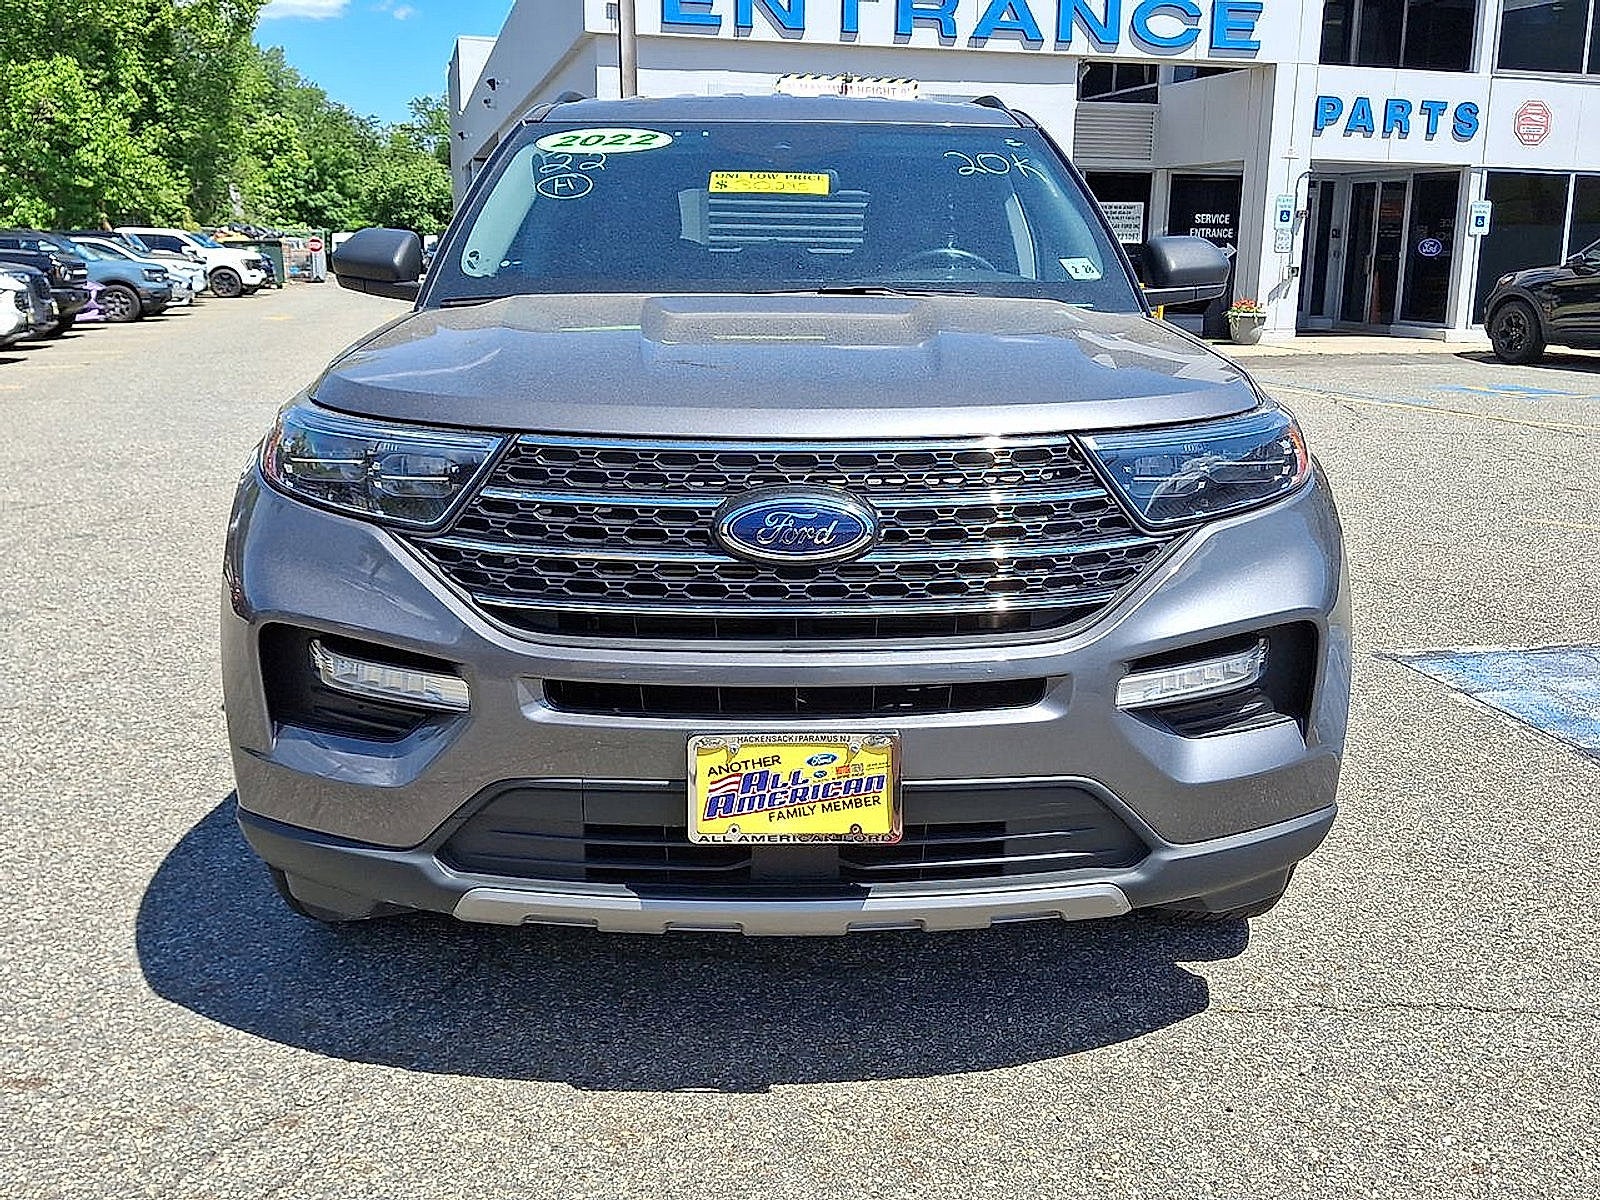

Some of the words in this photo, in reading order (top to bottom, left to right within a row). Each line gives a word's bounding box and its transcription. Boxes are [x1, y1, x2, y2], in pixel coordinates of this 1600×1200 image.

[1312, 95, 1480, 141] PARTS
[551, 133, 659, 148] 2022
[1195, 213, 1230, 224] SERVICE
[1190, 228, 1233, 238] ENTRANCE
[756, 510, 839, 545] Ford
[840, 735, 850, 743] NJ
[707, 754, 782, 778] ANOTHER
[739, 769, 810, 795] ALL
[705, 774, 885, 818] AMERICAN
[768, 804, 817, 822] FAMILY
[821, 795, 881, 814] MEMBER
[698, 835, 732, 843] ALL
[738, 835, 841, 843] AMERICAN
